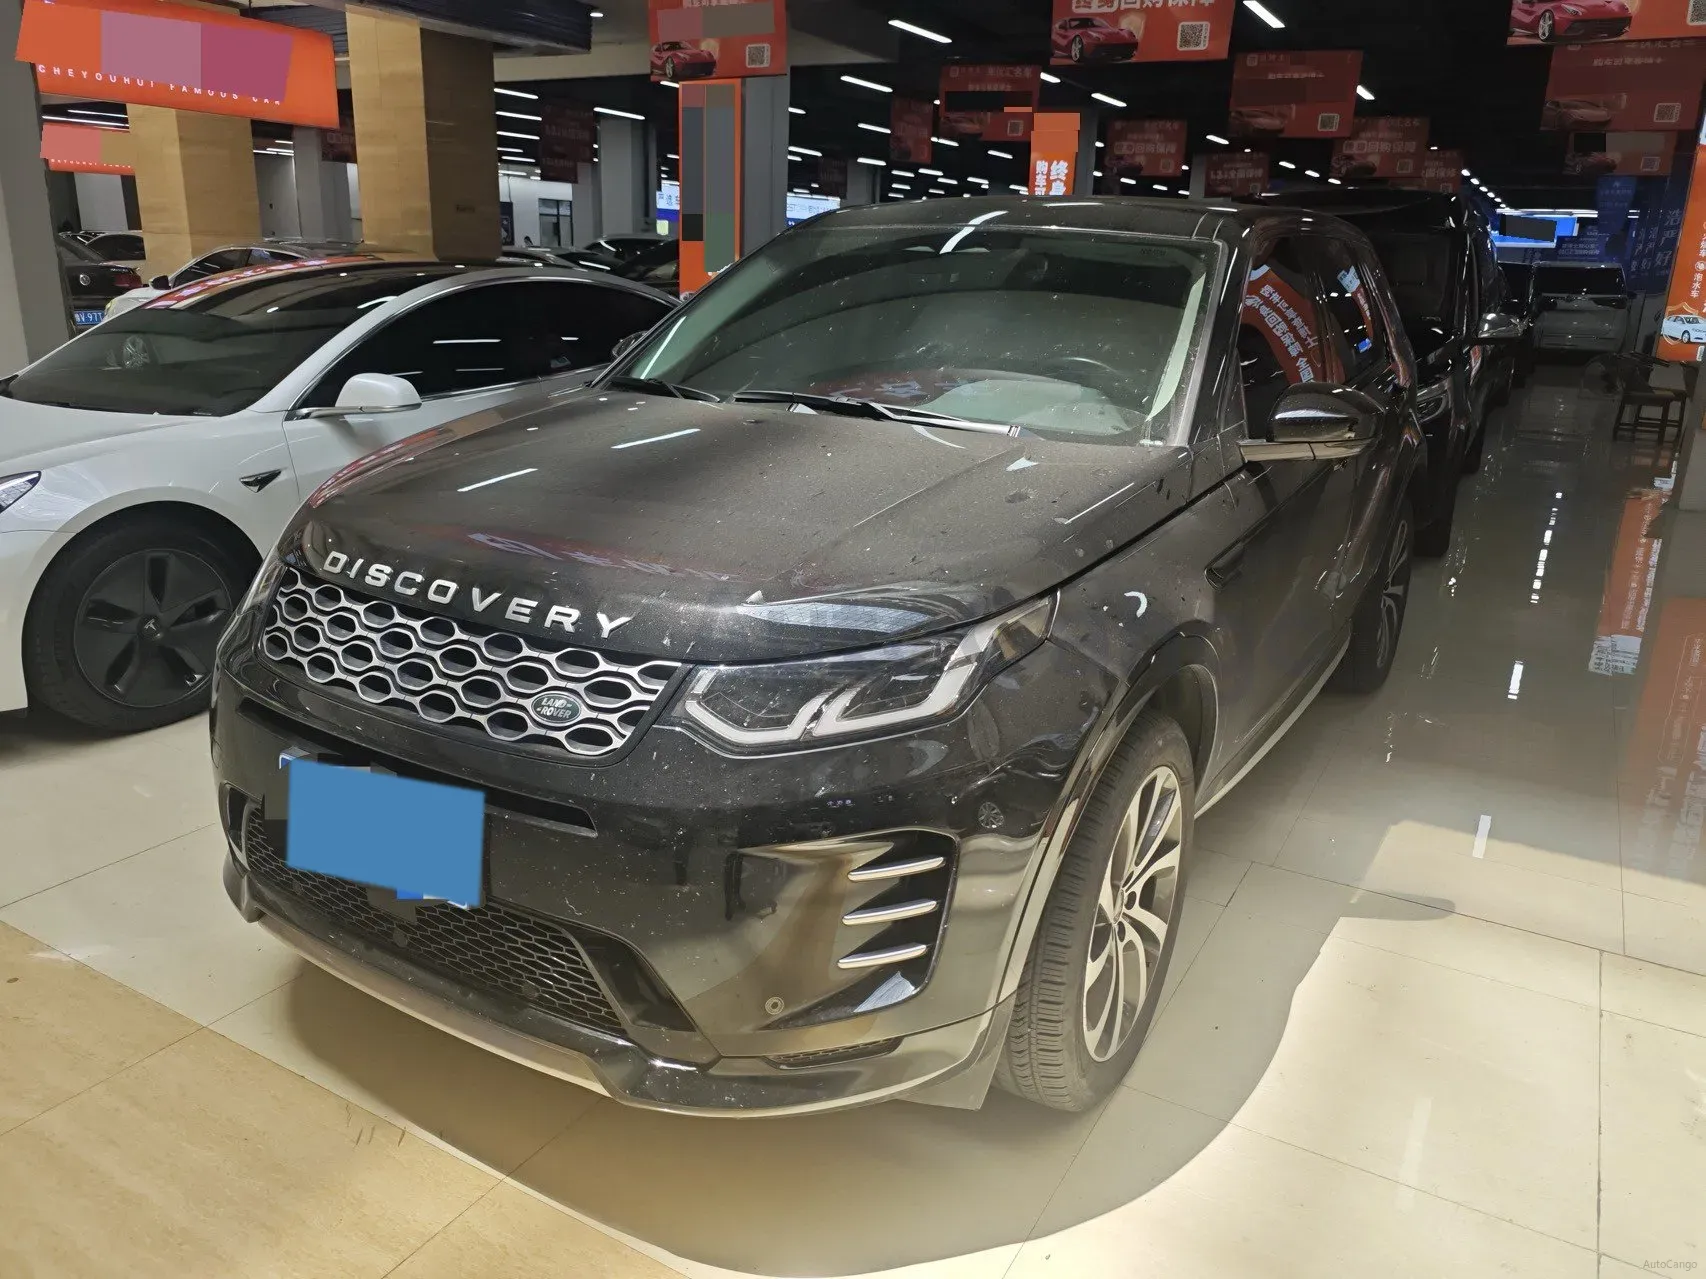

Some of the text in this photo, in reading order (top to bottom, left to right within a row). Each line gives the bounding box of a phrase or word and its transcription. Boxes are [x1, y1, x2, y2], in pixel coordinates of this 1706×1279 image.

[38, 64, 154, 88] CHEYOUHUI
[323, 551, 633, 640] DISCOVERY
[541, 697, 567, 709] LAND
[540, 706, 572, 719] ROVER
